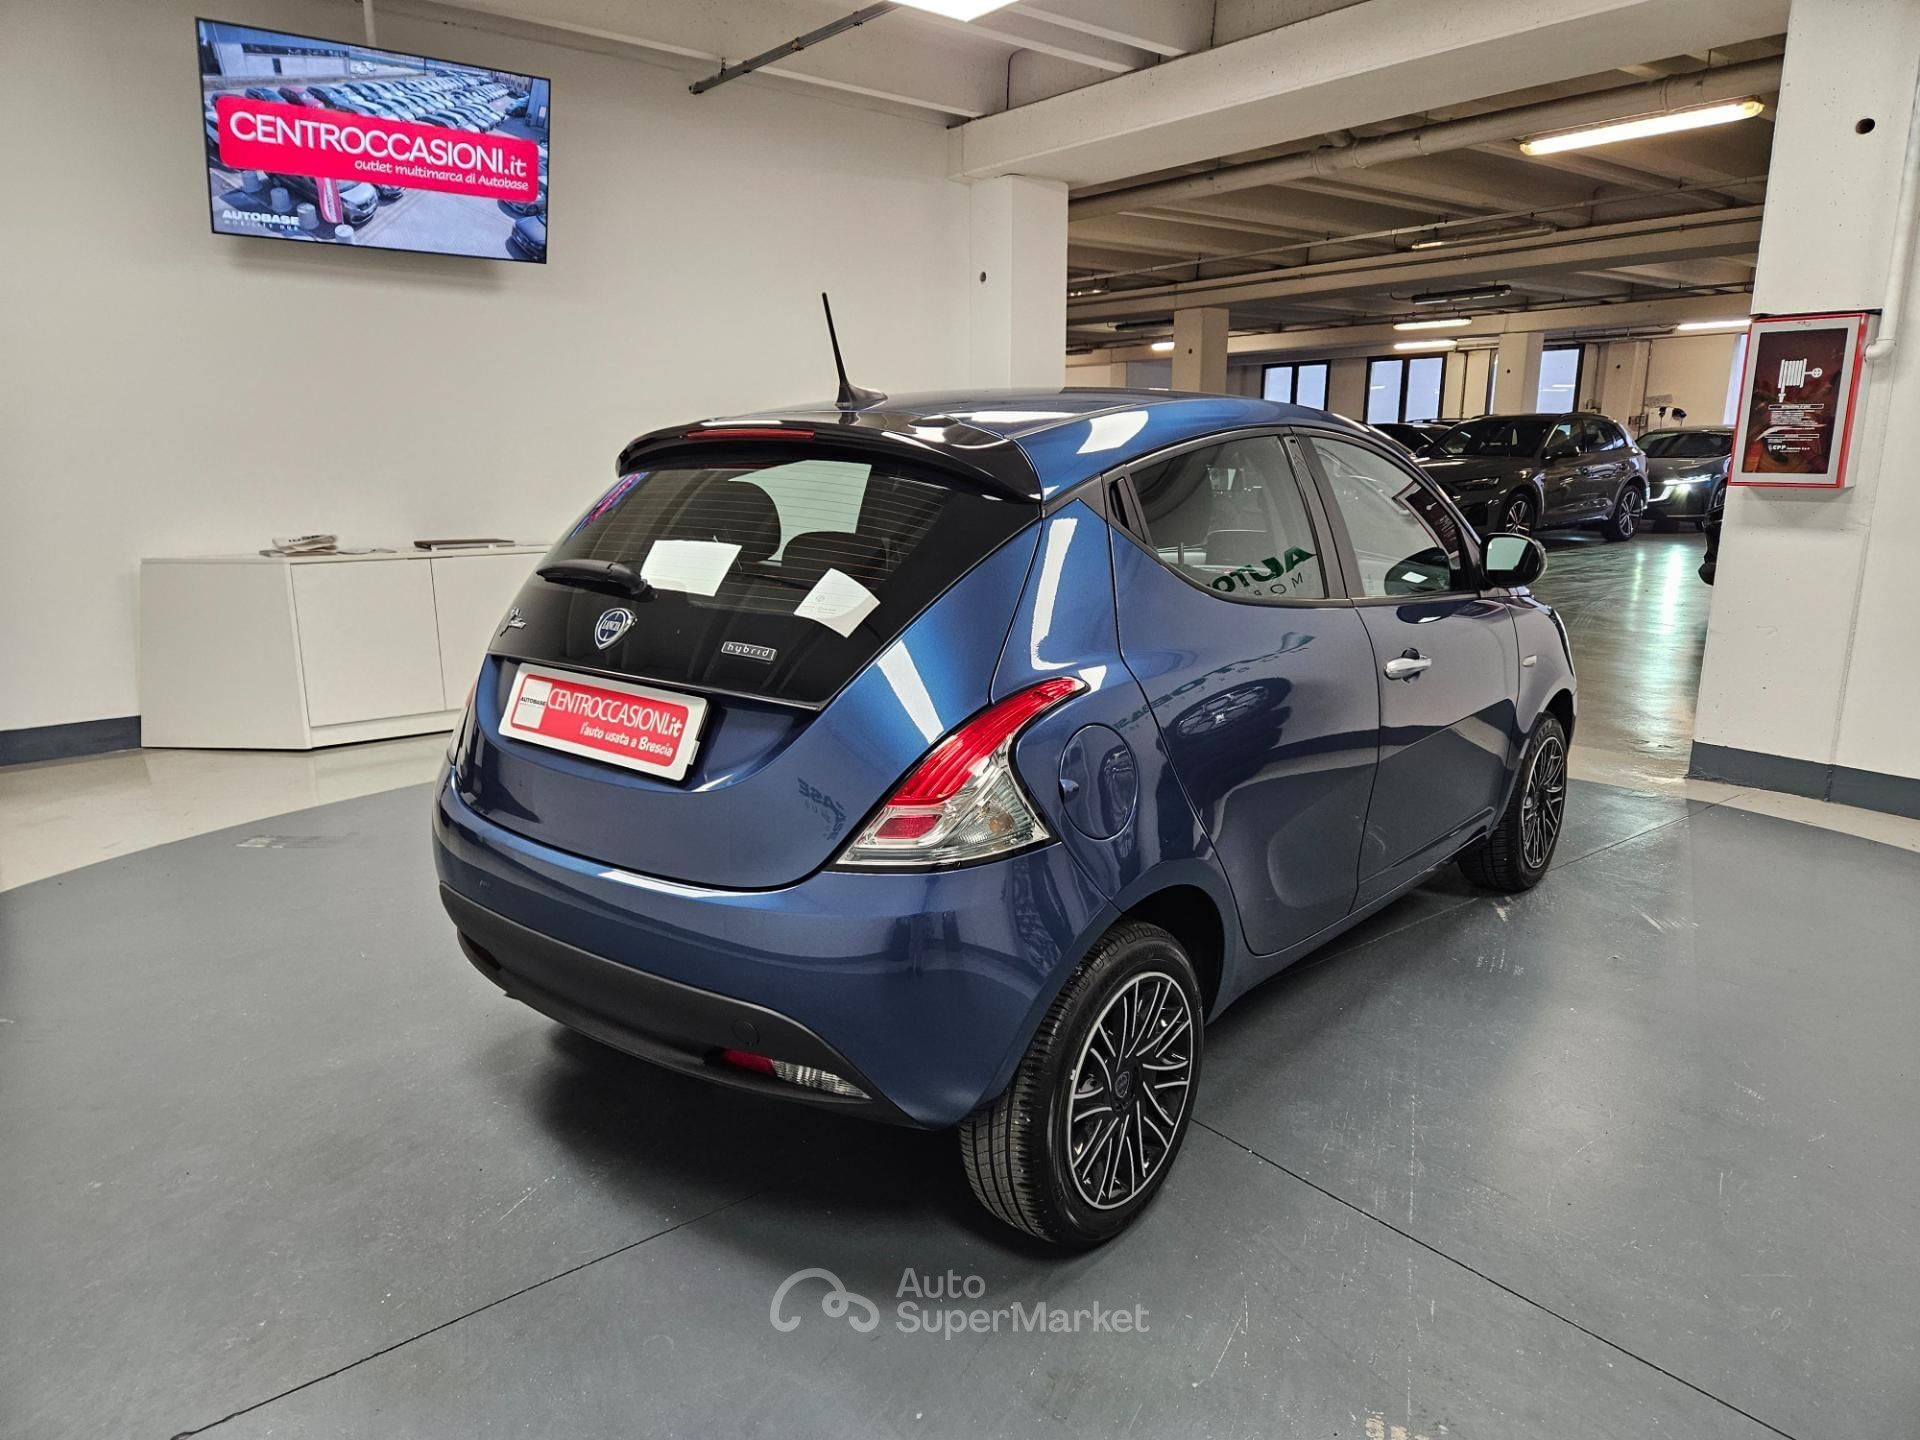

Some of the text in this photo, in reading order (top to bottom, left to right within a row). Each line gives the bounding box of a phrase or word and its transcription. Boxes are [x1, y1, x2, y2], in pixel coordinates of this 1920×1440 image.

[229, 110, 527, 178] CENTROCCASIONI.it
[354, 159, 529, 191] outlet multimarca di Autobase
[222, 209, 300, 226] AUTOBASE
[727, 642, 770, 657] hybrid
[548, 688, 682, 738] CENTROCCASIONI.it
[580, 721, 673, 757] l'auto usata a Brescia
